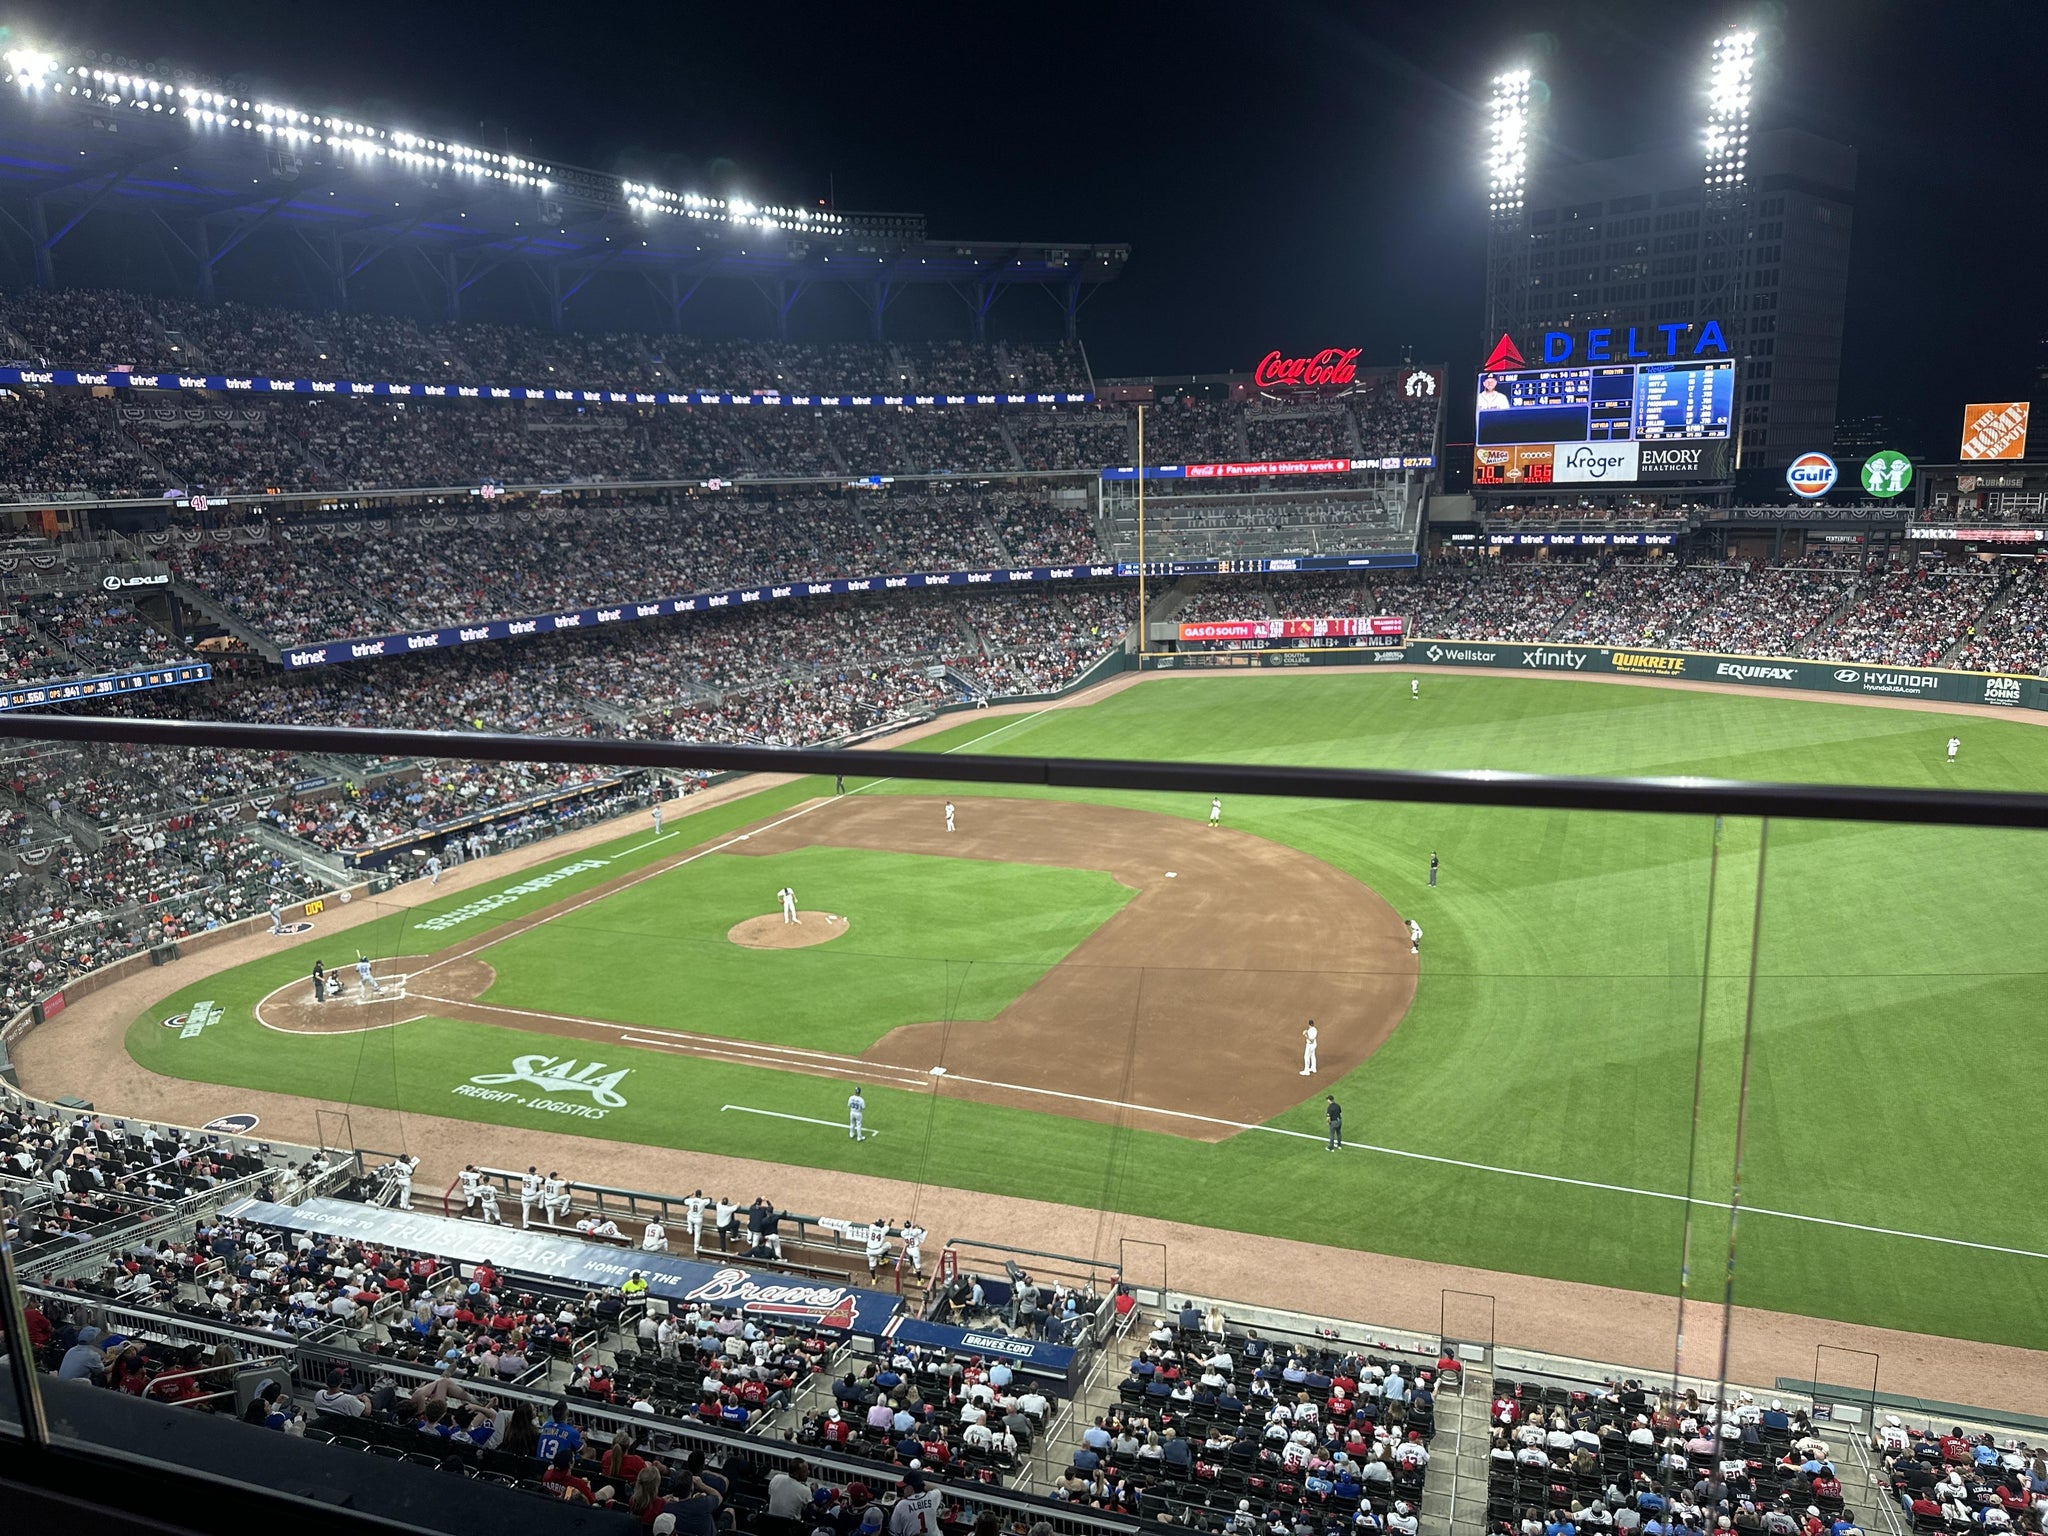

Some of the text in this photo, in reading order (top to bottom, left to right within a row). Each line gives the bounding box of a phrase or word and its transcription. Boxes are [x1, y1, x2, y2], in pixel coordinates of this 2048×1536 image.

[1544, 320, 1728, 364] DELTA
[1255, 348, 1363, 387] Coca-Cola
[21, 372, 53, 382] trinet
[77, 374, 107, 384] trinet
[130, 376, 158, 386] trinet
[179, 377, 206, 387] trinet
[226, 379, 251, 389] trinet
[270, 380, 295, 390] trinet
[1970, 409, 1996, 432] THE
[1962, 403, 2029, 459] HOME
[1986, 422, 2027, 459] DEPOT
[1566, 447, 1624, 478] Kroger
[1641, 449, 1702, 465] EMORY
[1226, 466, 1242, 474] Fan
[1244, 464, 1268, 474] work
[1269, 464, 1276, 472] is
[1278, 462, 1308, 474] thirsty
[1310, 461, 1334, 471] work
[1478, 466, 1495, 478] 70
[1529, 465, 1552, 477] 166
[1642, 464, 1699, 472] HEALTHCARE
[1791, 468, 1832, 482] Gulf
[1976, 478, 2021, 487] CLUBHOUSE
[191, 496, 208, 510] 41
[1187, 504, 1373, 528] HANK AARON TERRACE
[1491, 535, 1671, 544] trinet trinet trinet trinet trinet trinet
[122, 574, 168, 586] LEXUS
[291, 649, 327, 666] trinet
[352, 642, 385, 657] trinet
[408, 634, 439, 648] trinet
[460, 627, 490, 641] trinet
[509, 621, 537, 634] trinet
[555, 615, 581, 628] trinet
[597, 610, 622, 622] trinet
[637, 605, 660, 616] trinet
[674, 600, 696, 611] trinet
[809, 584, 832, 593] trinet
[848, 581, 871, 590] trinet
[886, 578, 908, 587] trinet
[926, 575, 950, 584] trinet
[968, 573, 993, 582] trinet
[1010, 571, 1034, 580] trinet
[1051, 569, 1074, 578] trinet
[1091, 567, 1114, 576] trinet
[1185, 626, 1248, 637] GAS SOUTH
[1254, 626, 1267, 636] AL
[1242, 636, 1398, 650] MLB+ MLB+ MLB+
[1446, 649, 1496, 662] Wellstar
[1522, 648, 1587, 670] xfinity
[1612, 652, 1685, 671] QUIKRETE
[1716, 662, 1794, 680] EQUIFAX
[1864, 672, 1938, 688] HYUNDAI
[1863, 684, 1921, 694] HyundaiUSA.com
[1986, 678, 2020, 690] PAPA
[13, 694, 24, 704] SLG
[50, 688, 61, 699] OPS
[84, 684, 94, 694] OBP
[1984, 689, 2020, 699] JOHNS
[504, 859, 611, 896] Harrah's
[414, 894, 504, 929] CASINOS
[470, 1054, 631, 1108] SAIA
[451, 1084, 519, 1103] FREIGHT
[527, 1098, 610, 1120] LOGISTICS
[291, 1209, 576, 1269] WELCOME TO TRUIST PARK
[584, 1260, 682, 1286] HOME OF THE
[685, 1268, 847, 1306] Braves
[966, 1334, 1031, 1354] BRAVES.COM
[1305, 1413, 1318, 1424] 22
[540, 1438, 560, 1460] 13
[1888, 1438, 1900, 1448] 38
[1288, 1453, 1301, 1463] 35
[908, 1500, 932, 1513] ALBIES
[918, 1512, 928, 1534] 1
